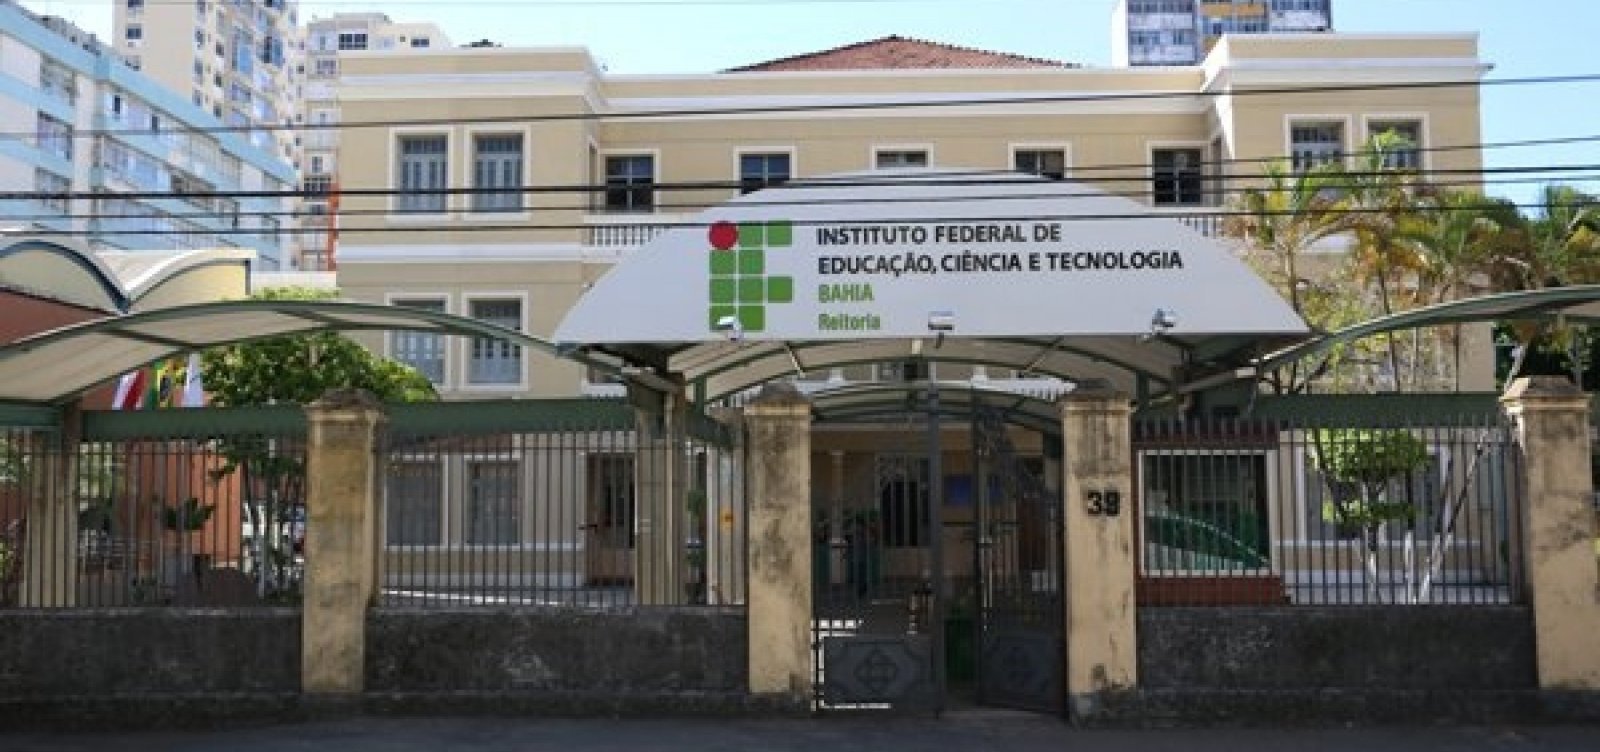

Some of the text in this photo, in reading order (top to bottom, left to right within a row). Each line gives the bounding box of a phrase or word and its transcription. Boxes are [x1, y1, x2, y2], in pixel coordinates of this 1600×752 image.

[817, 223, 1062, 246] INSTITUTO FEDERAL DE
[818, 250, 1184, 277] EDUCAÇÃO, CIÊNCIA E TECNOLOGIA
[818, 284, 874, 303] BAHIA
[818, 313, 881, 331] Reitoria
